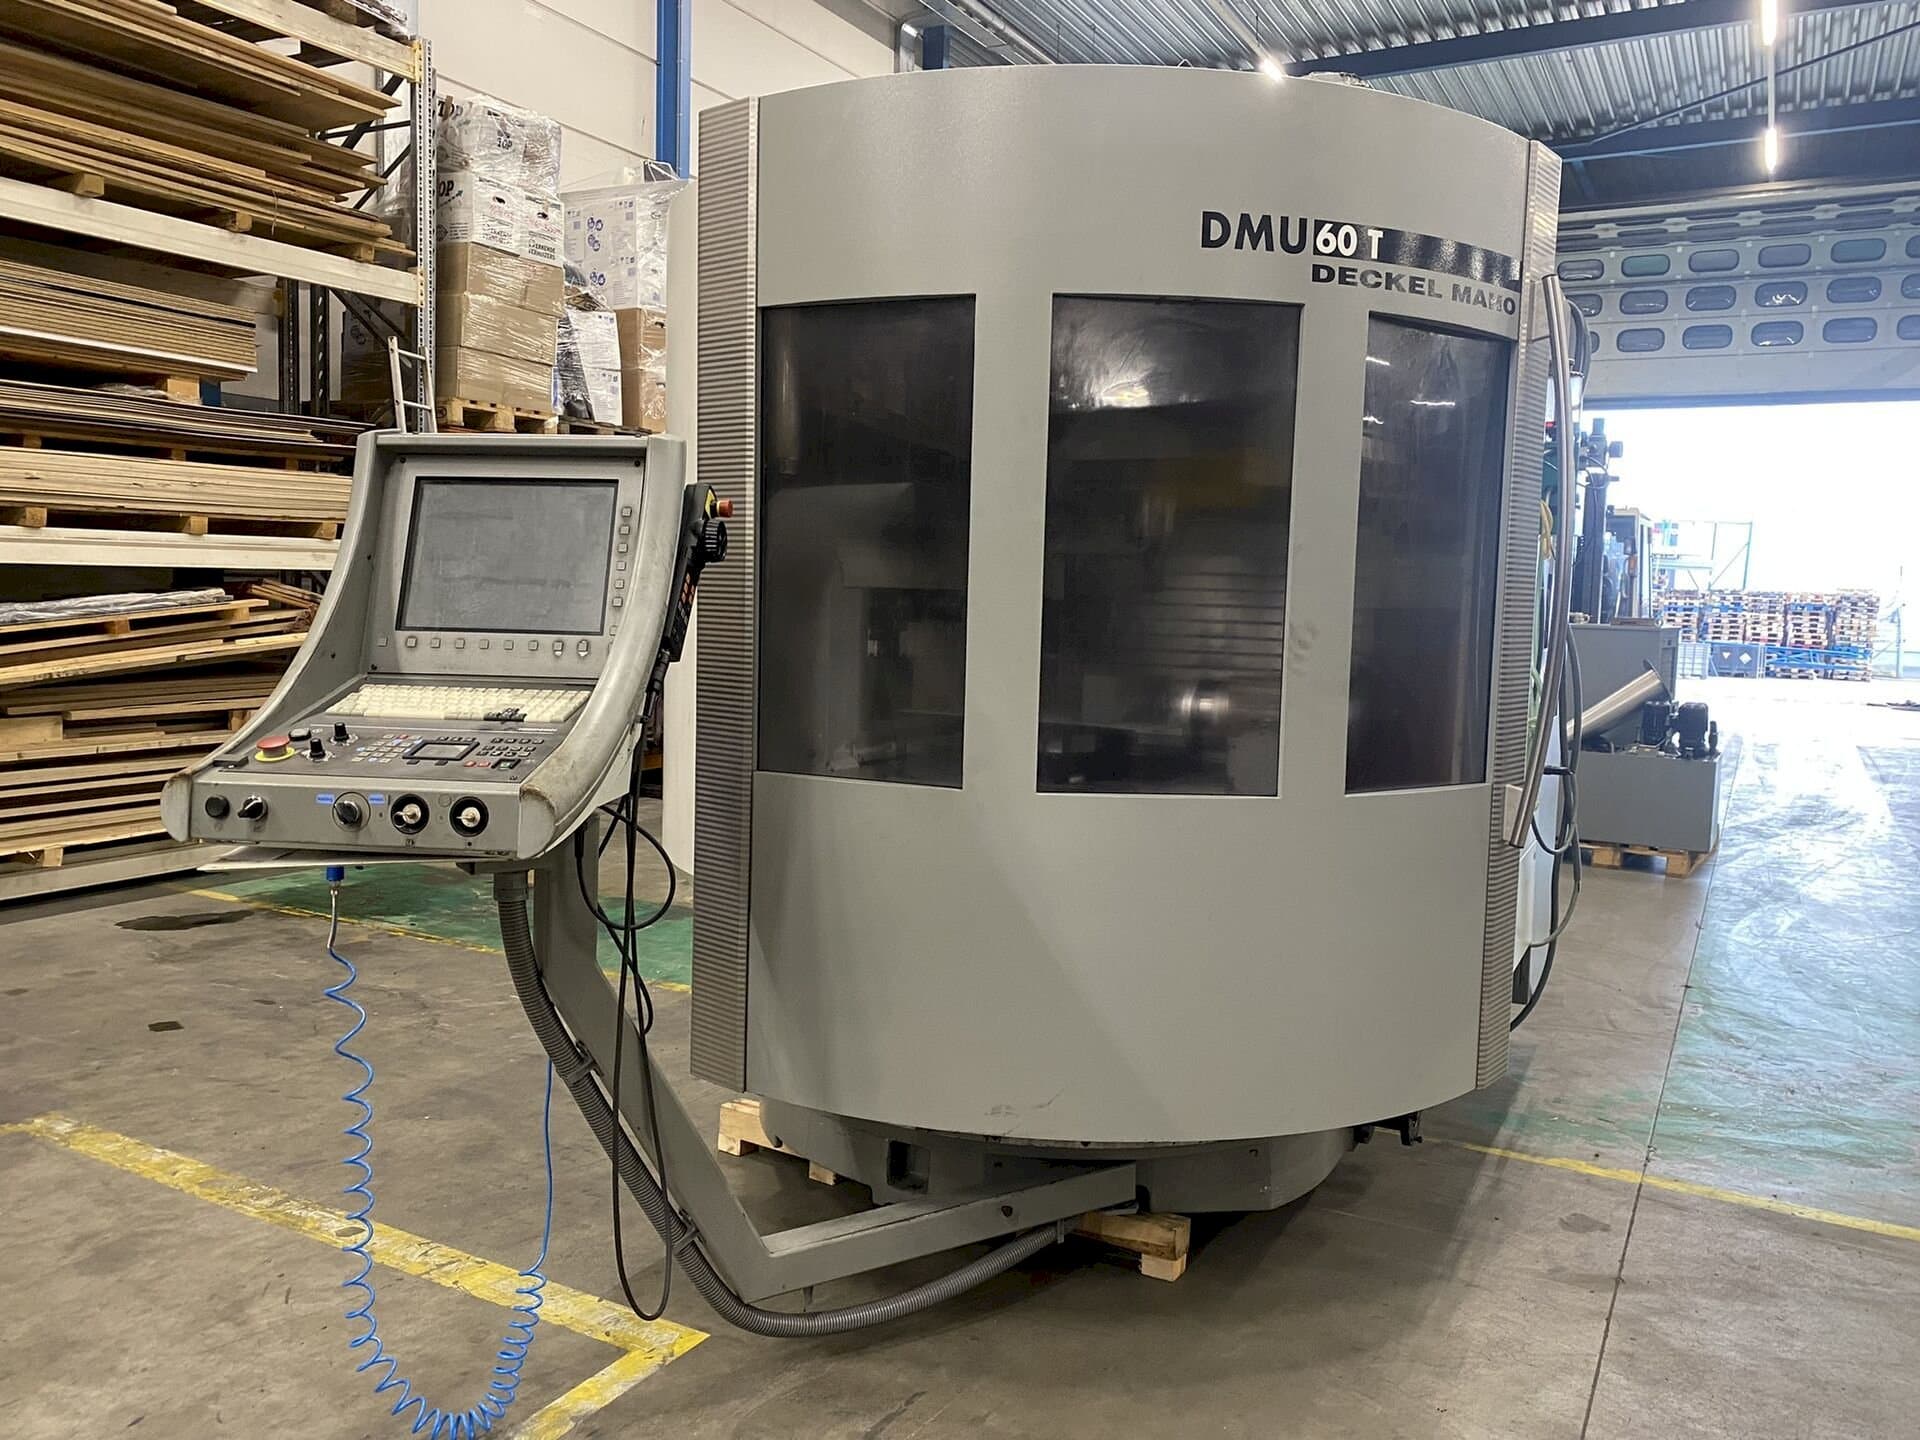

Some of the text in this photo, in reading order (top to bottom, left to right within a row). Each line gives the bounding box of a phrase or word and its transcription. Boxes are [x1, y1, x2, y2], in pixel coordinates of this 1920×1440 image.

[439, 180, 455, 197] OP
[1367, 228, 1384, 260] T
[1311, 263, 1516, 316] DECKEL MAHO
